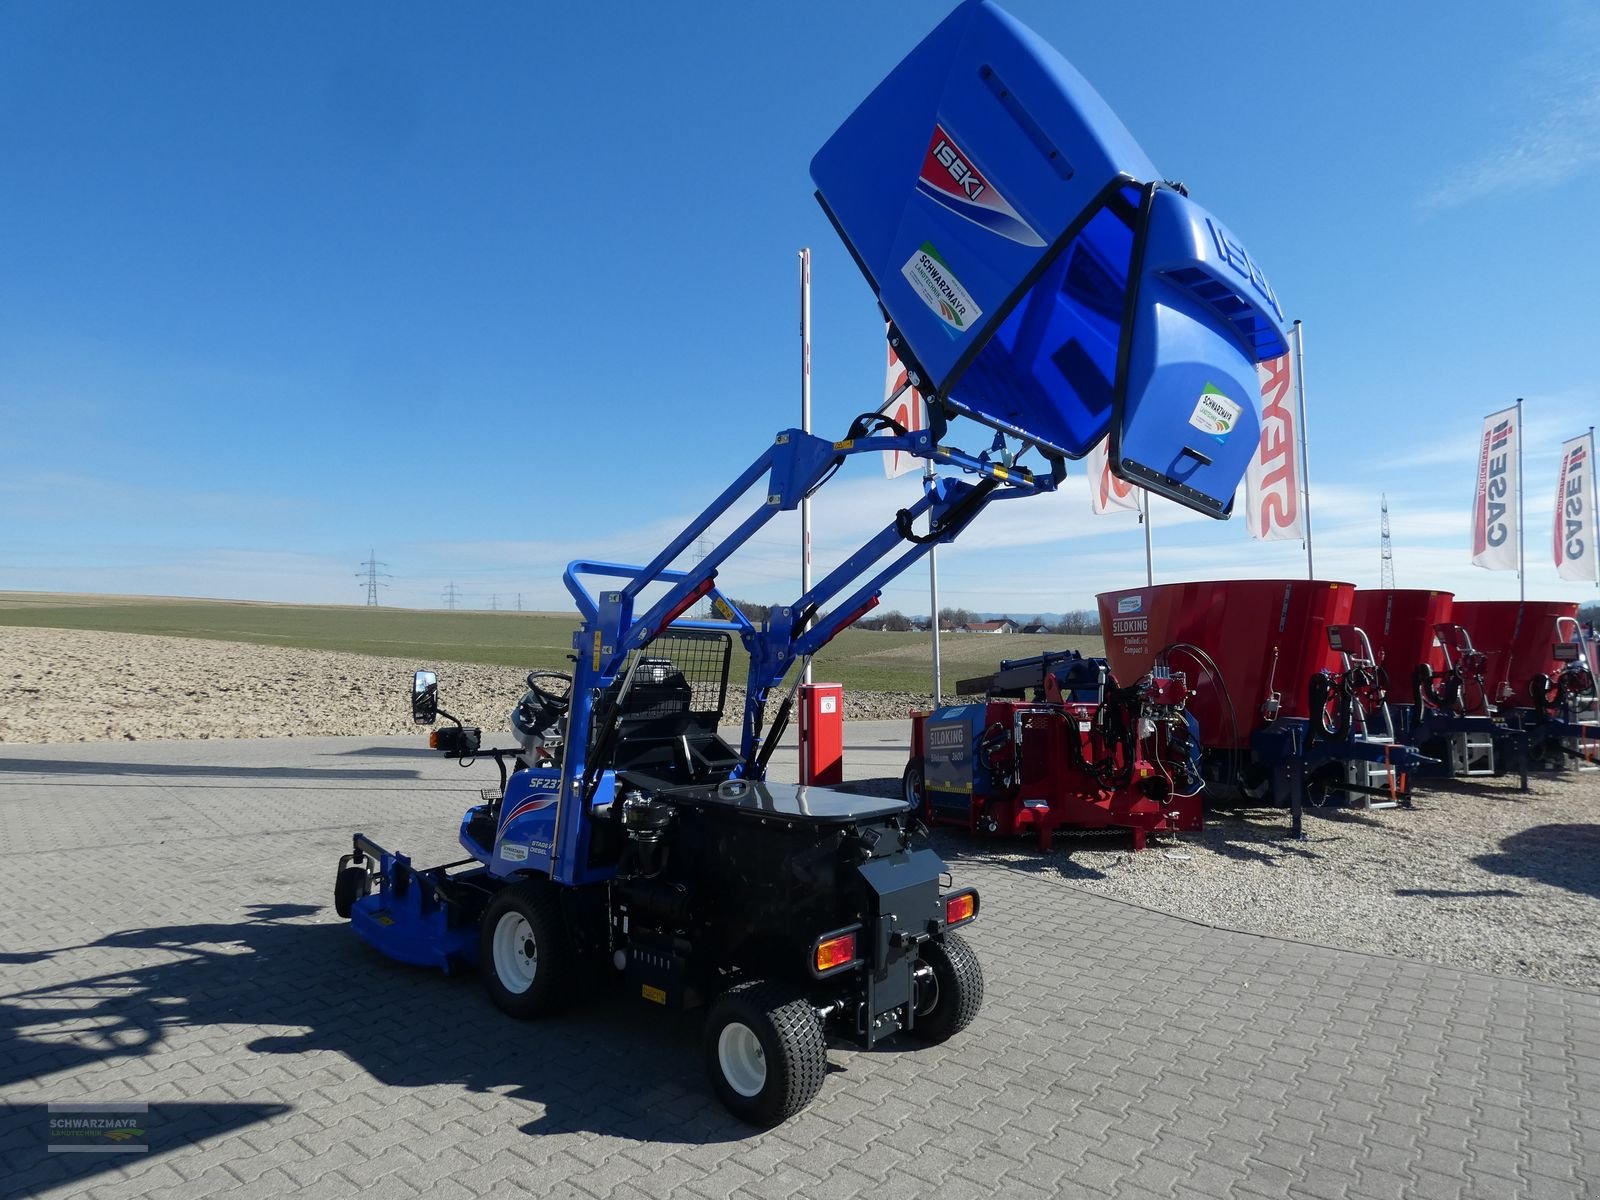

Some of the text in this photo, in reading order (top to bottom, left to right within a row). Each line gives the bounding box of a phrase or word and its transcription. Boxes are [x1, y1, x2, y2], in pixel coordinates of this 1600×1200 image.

[932, 140, 986, 201] ISEKI
[919, 254, 966, 316] SCHWARZMAYR
[1113, 620, 1148, 633] SILOKING
[930, 729, 963, 745] SILOKING
